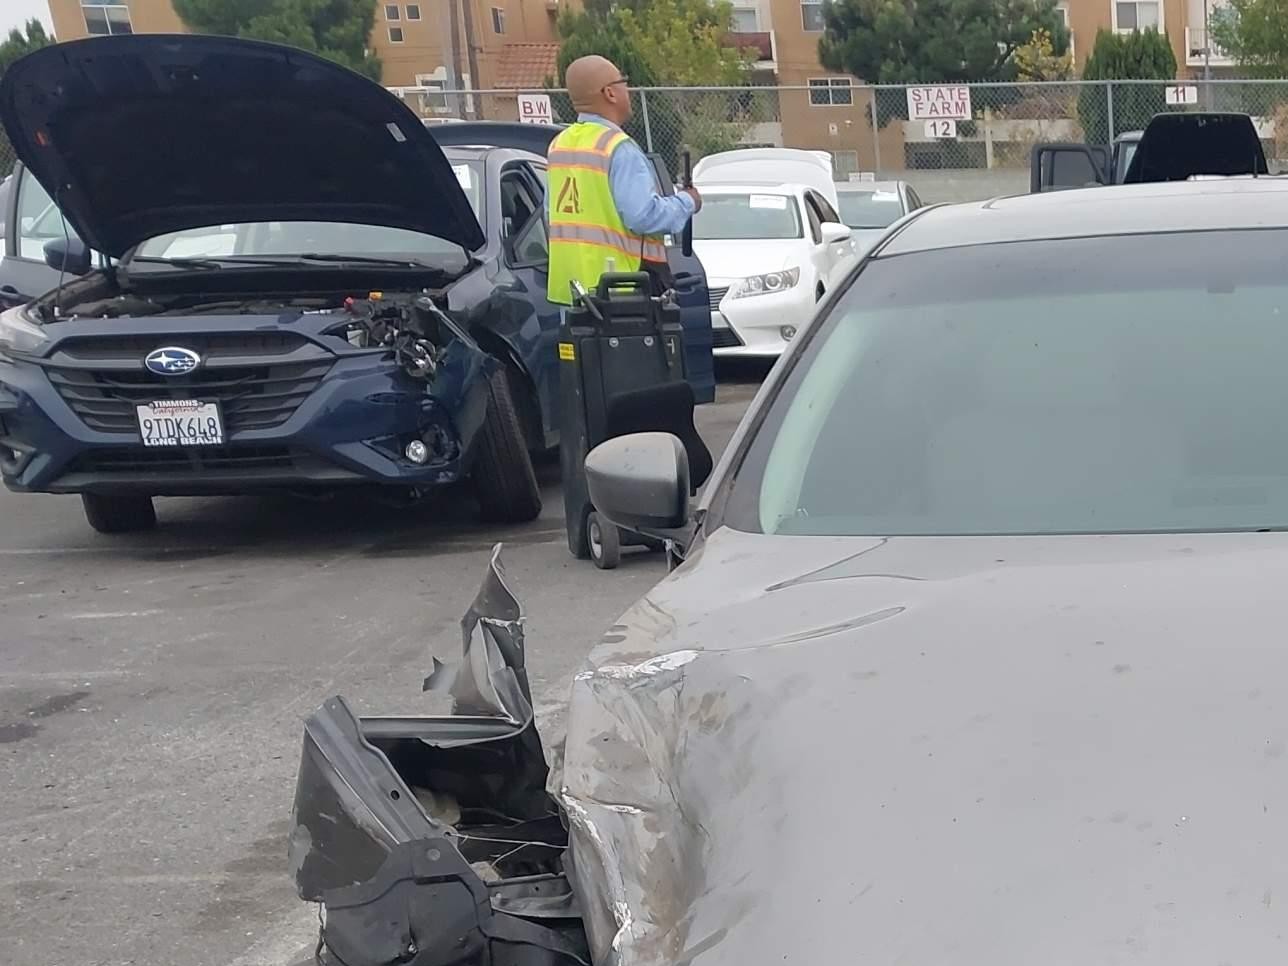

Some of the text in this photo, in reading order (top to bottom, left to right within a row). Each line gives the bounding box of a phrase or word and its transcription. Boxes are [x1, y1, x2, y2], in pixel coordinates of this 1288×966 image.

[912, 87, 968, 102] STATE
[1173, 87, 1186, 102] 11
[915, 101, 966, 115] FARM
[930, 121, 951, 136] 12
[152, 400, 198, 408] TIMMONS
[143, 417, 218, 440] 9TDK648
[143, 436, 222, 446] LONG BEACH
